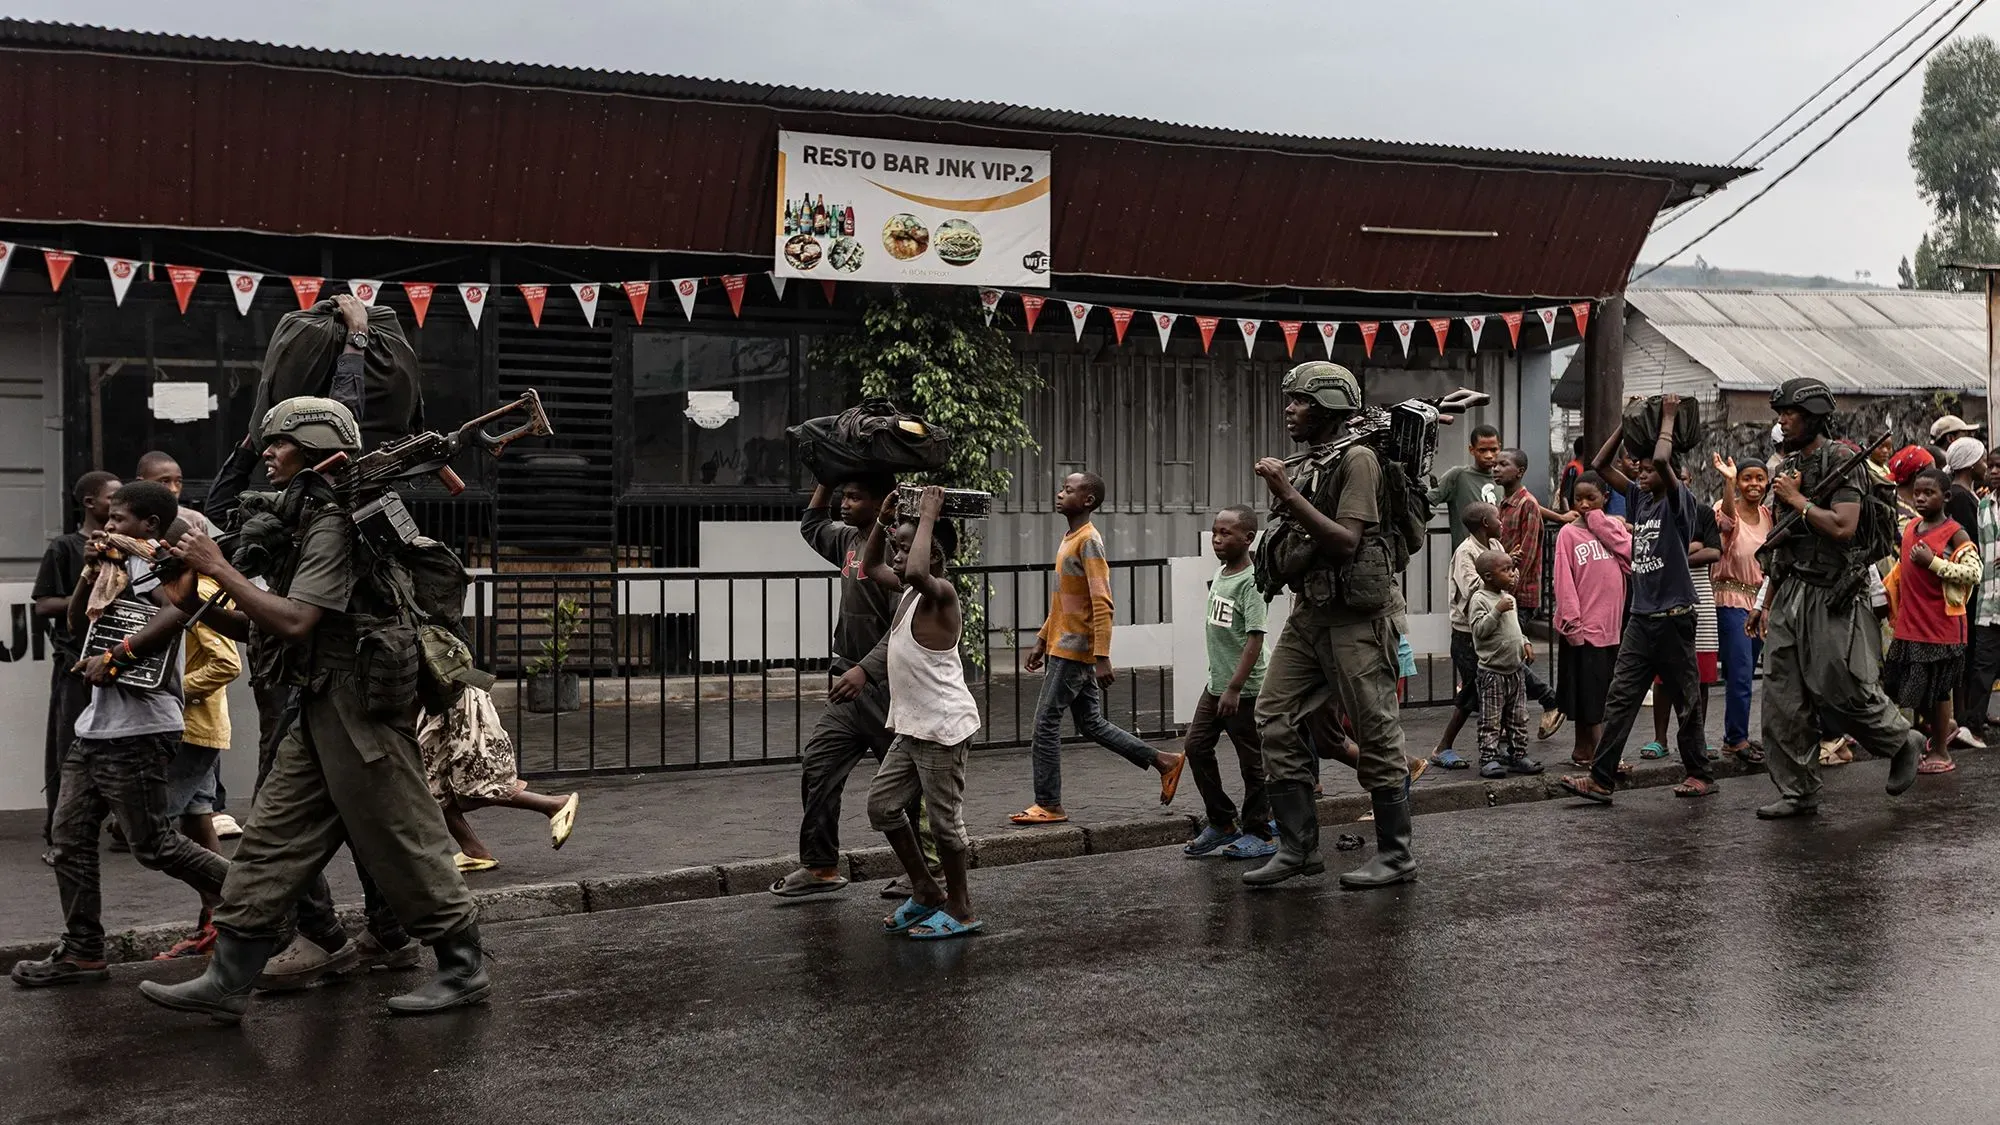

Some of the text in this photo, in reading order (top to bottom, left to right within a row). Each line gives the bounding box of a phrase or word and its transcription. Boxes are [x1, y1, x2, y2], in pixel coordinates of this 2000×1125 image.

[803, 145, 1034, 182] RESTO BAR JNK VIP.2
